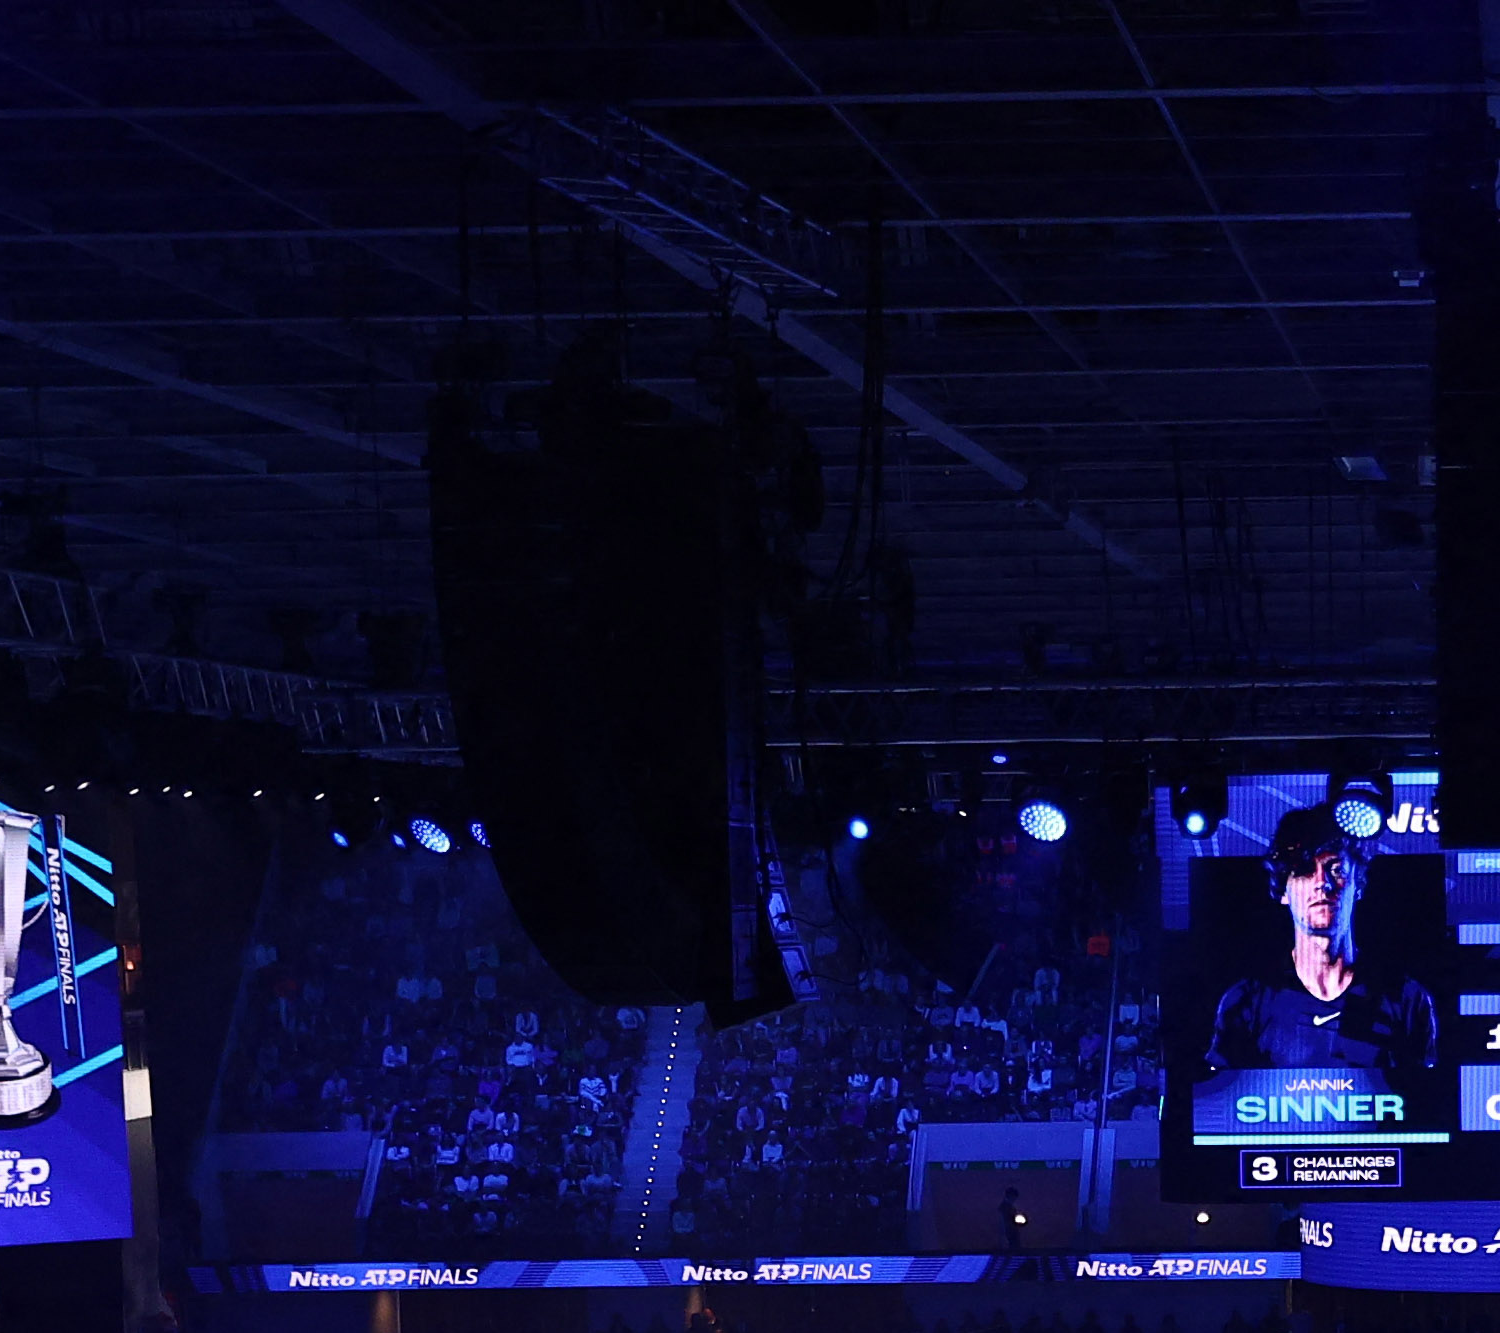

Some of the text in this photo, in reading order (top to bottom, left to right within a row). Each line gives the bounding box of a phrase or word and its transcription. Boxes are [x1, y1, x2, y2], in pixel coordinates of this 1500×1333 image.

[46, 846, 76, 1006] Nitto ATP FINALS
[1285, 1077, 1355, 1093] JANNIK
[1236, 1094, 1405, 1123] SINNER
[1252, 1156, 1278, 1181] 3
[1293, 1156, 1396, 1169] CHALLENGES
[1293, 1170, 1380, 1182] REMAINING
[1381, 1226, 1478, 1255] Nitto
[288, 1267, 479, 1288] Nitto ATP FINALS
[681, 1262, 873, 1282] Nitto ATP FINALS
[1075, 1258, 1268, 1277] Nitto ATP FINALS
